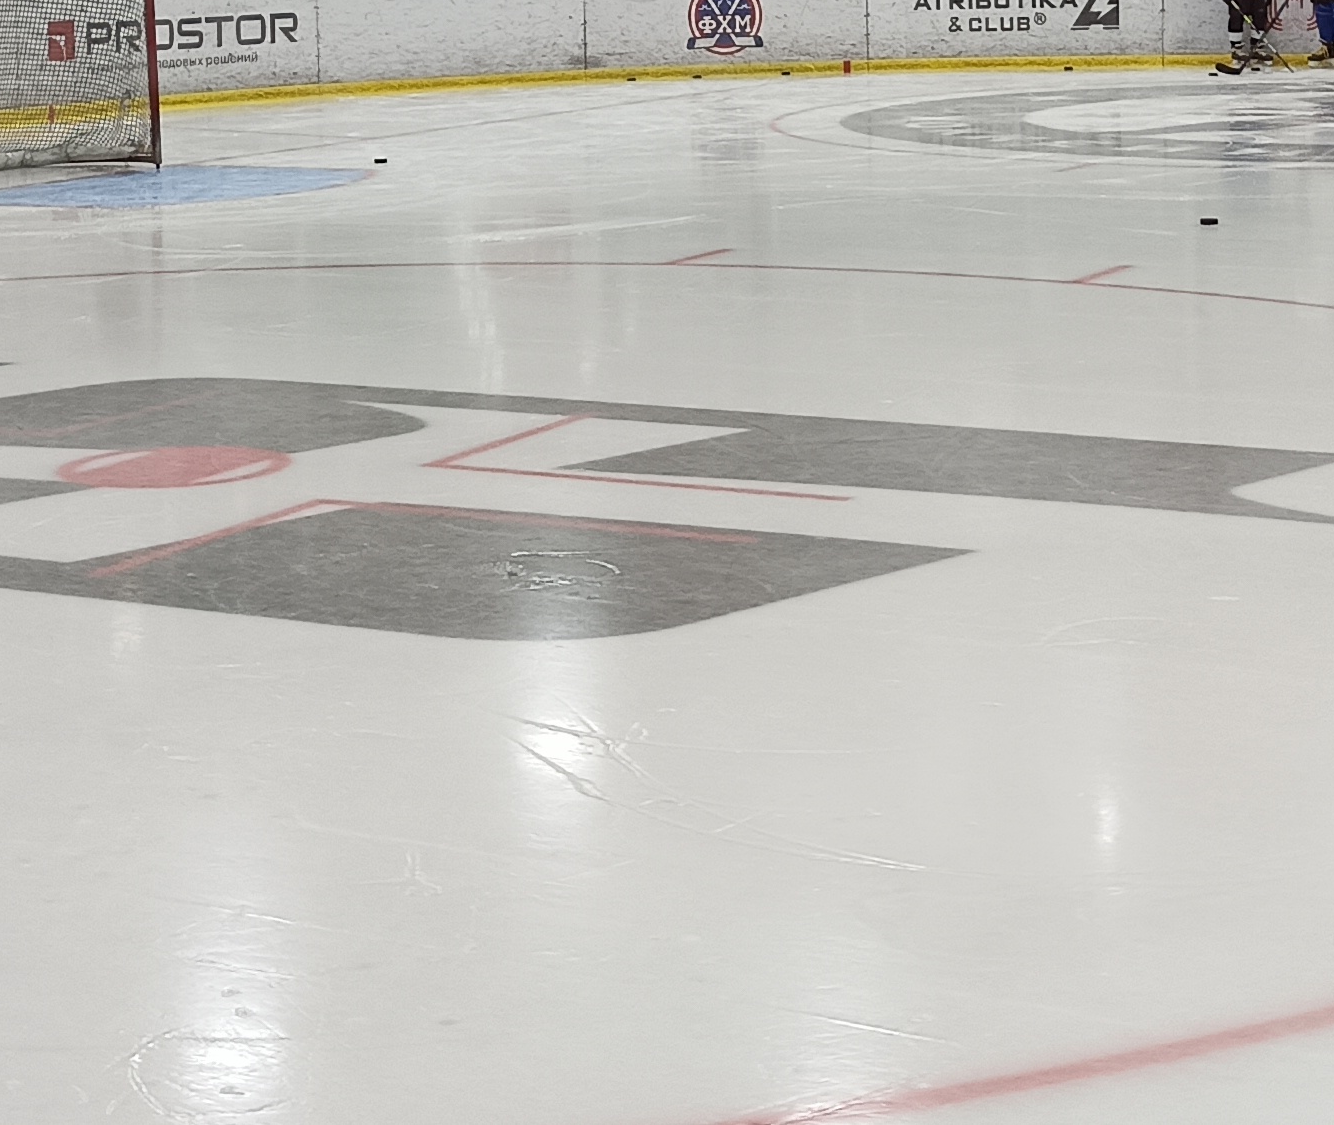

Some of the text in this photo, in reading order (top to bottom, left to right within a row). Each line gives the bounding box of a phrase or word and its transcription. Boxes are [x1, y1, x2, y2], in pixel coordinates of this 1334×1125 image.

[698, 15, 752, 33] ФХМ
[948, 16, 964, 32] &
[86, 12, 299, 55] PROSTOR
[205, 51, 259, 67] решений
